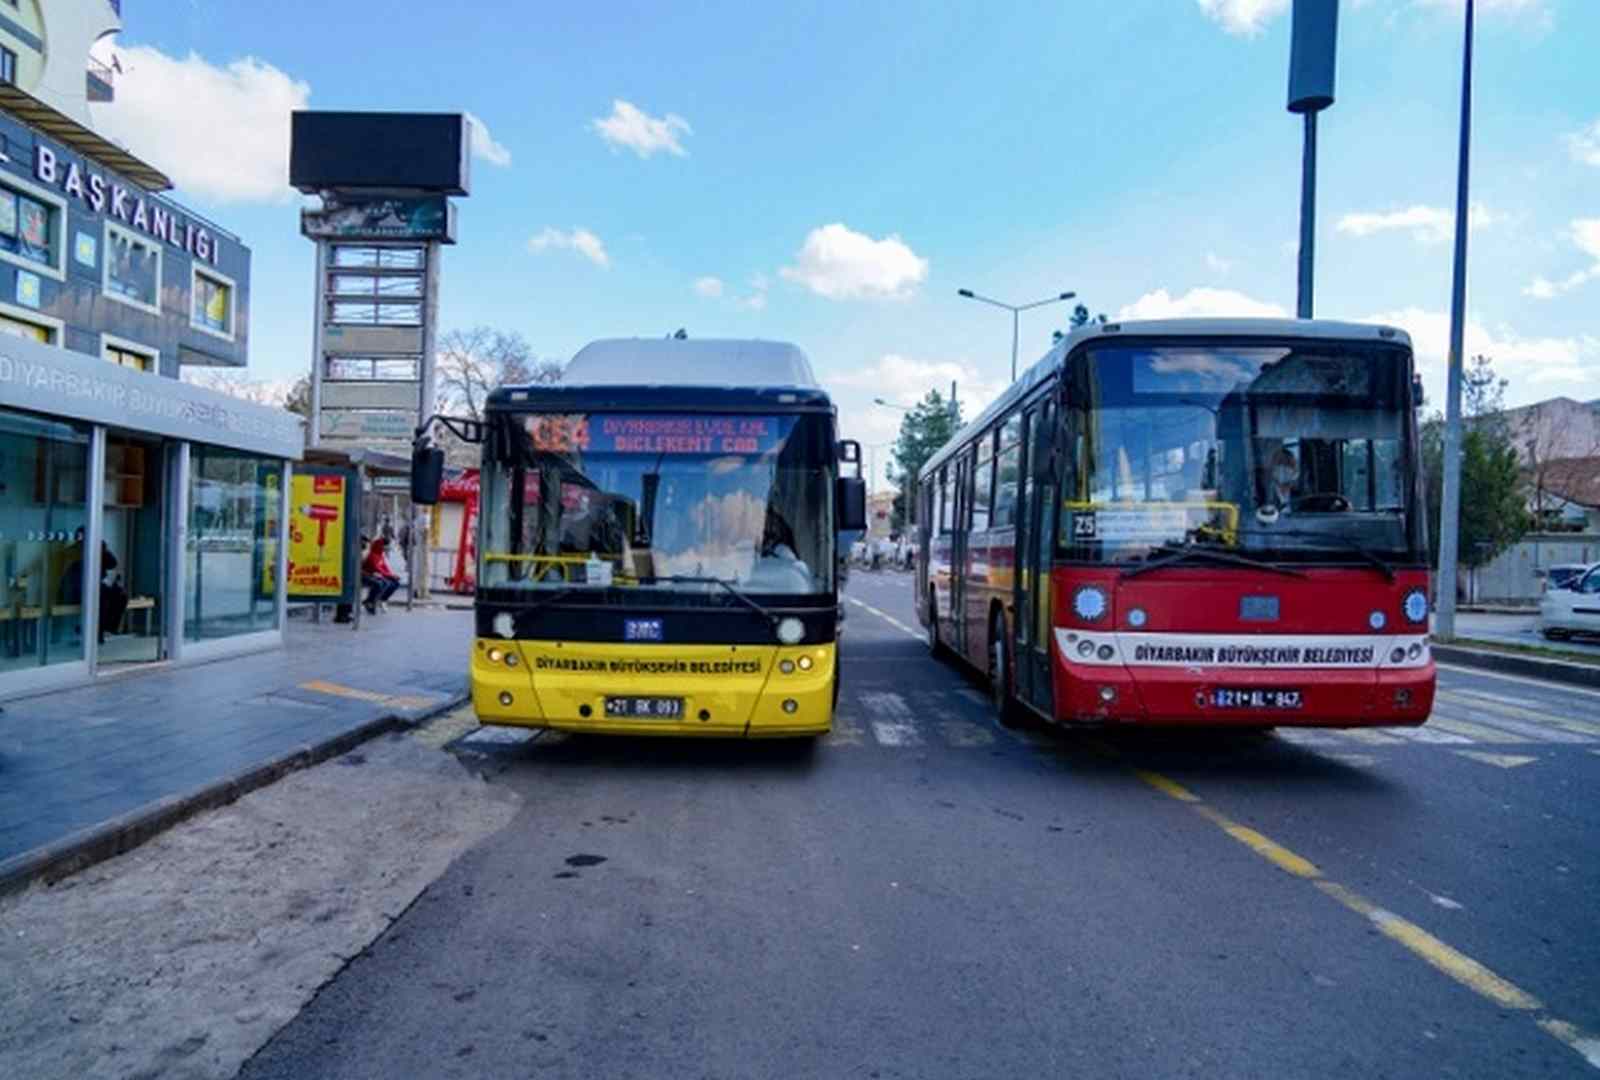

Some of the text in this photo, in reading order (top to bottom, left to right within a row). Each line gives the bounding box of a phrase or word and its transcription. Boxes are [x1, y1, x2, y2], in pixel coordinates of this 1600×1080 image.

[1135, 643, 1374, 664] DİYARBAKIR BÜYÜKŞEHİR BELEDİYESİ
